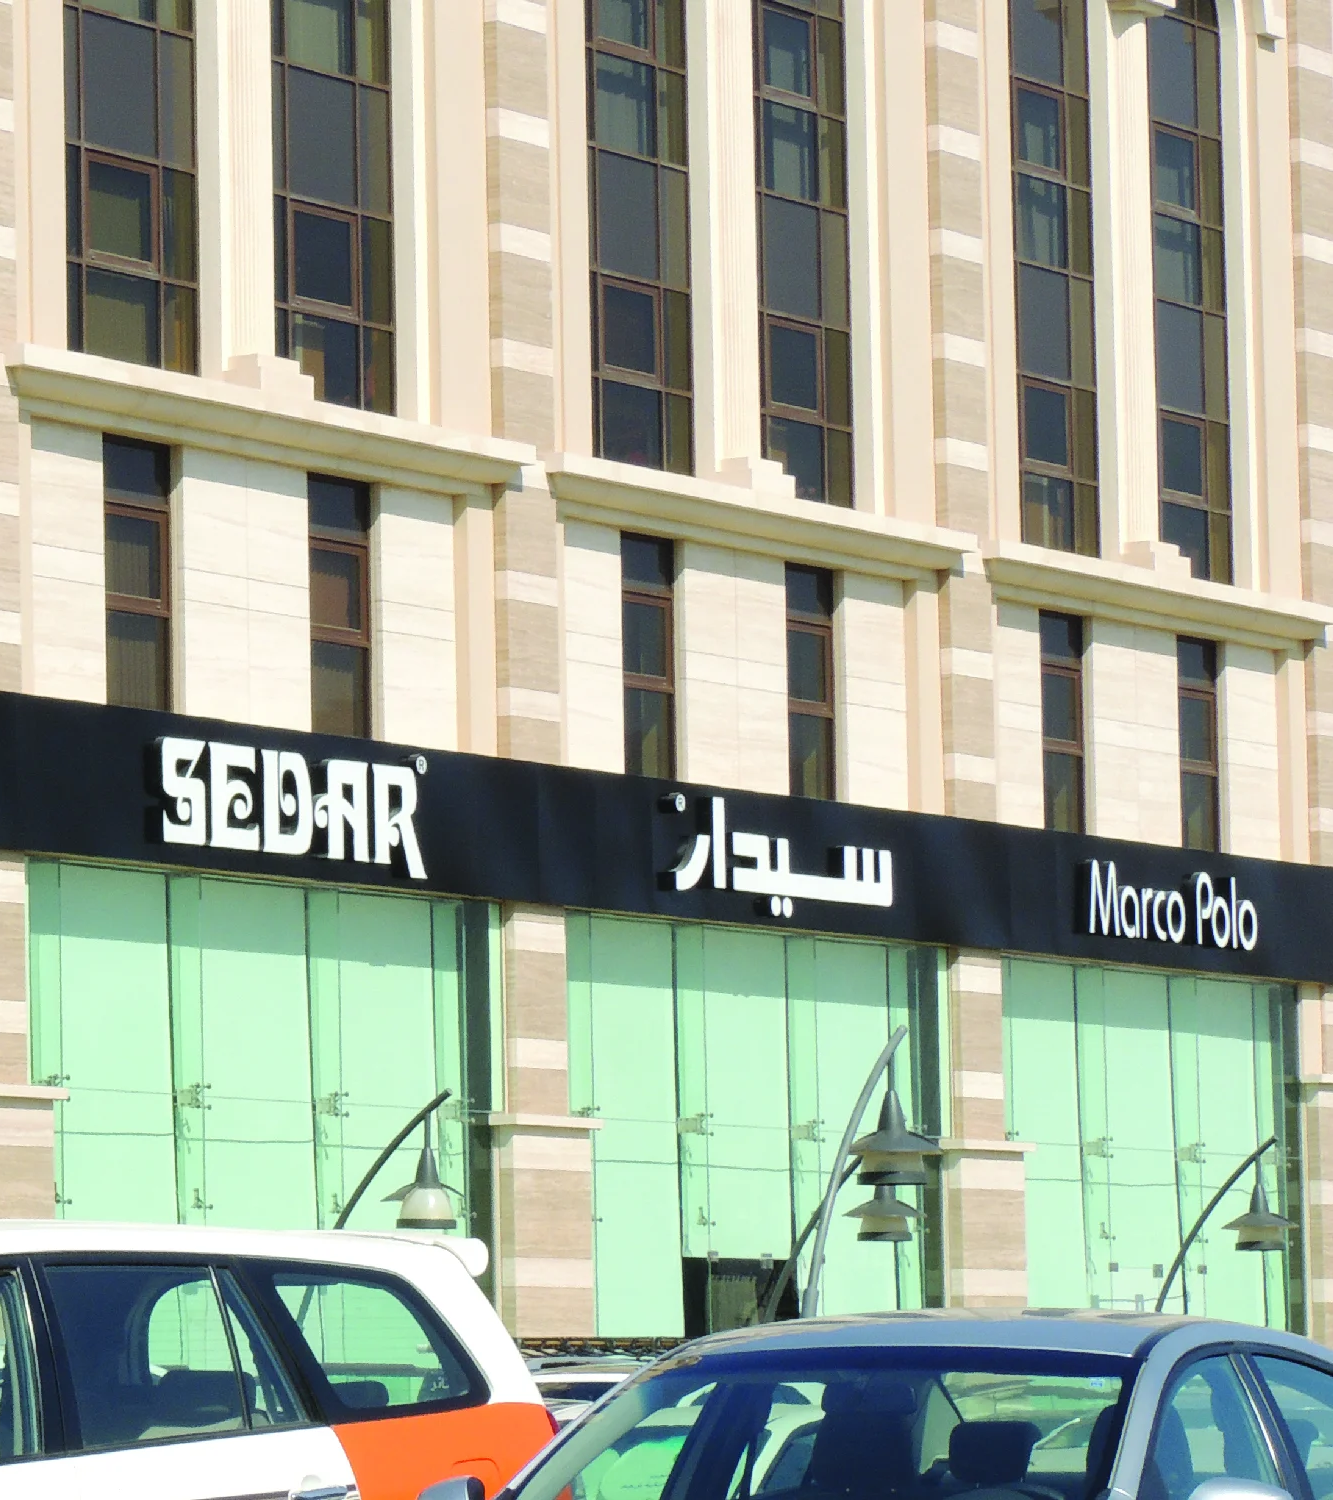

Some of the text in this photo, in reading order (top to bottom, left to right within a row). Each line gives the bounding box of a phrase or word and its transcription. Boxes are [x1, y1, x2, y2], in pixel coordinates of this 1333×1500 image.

[674, 796, 894, 919] سيدار
[1088, 858, 1258, 951] Marco Polo
